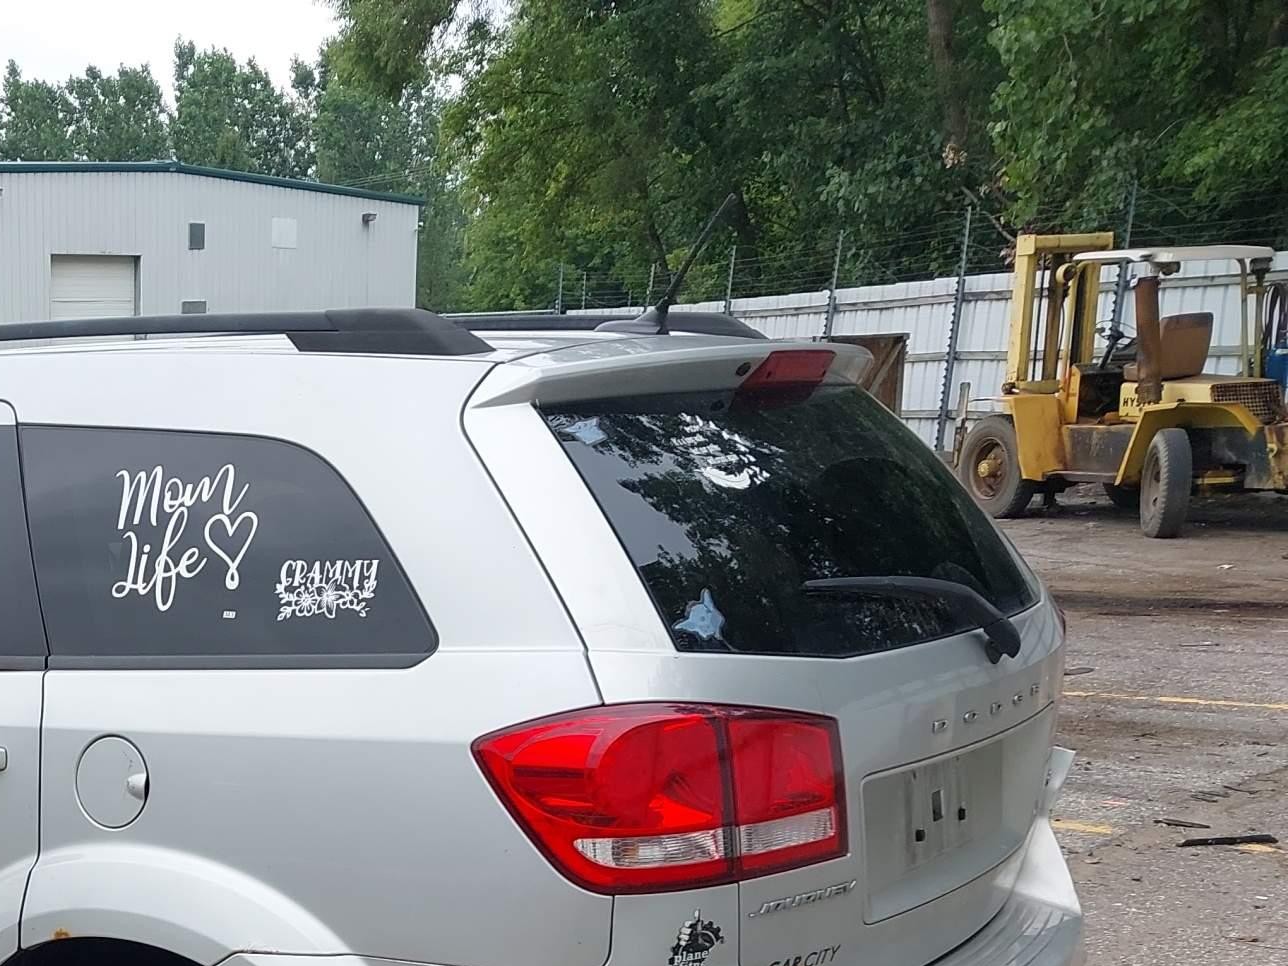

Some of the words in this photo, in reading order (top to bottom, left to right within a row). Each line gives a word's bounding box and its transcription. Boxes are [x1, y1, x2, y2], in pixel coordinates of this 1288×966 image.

[116, 464, 249, 529] Mom
[112, 506, 207, 611] Life
[280, 560, 379, 587] GRAMMY
